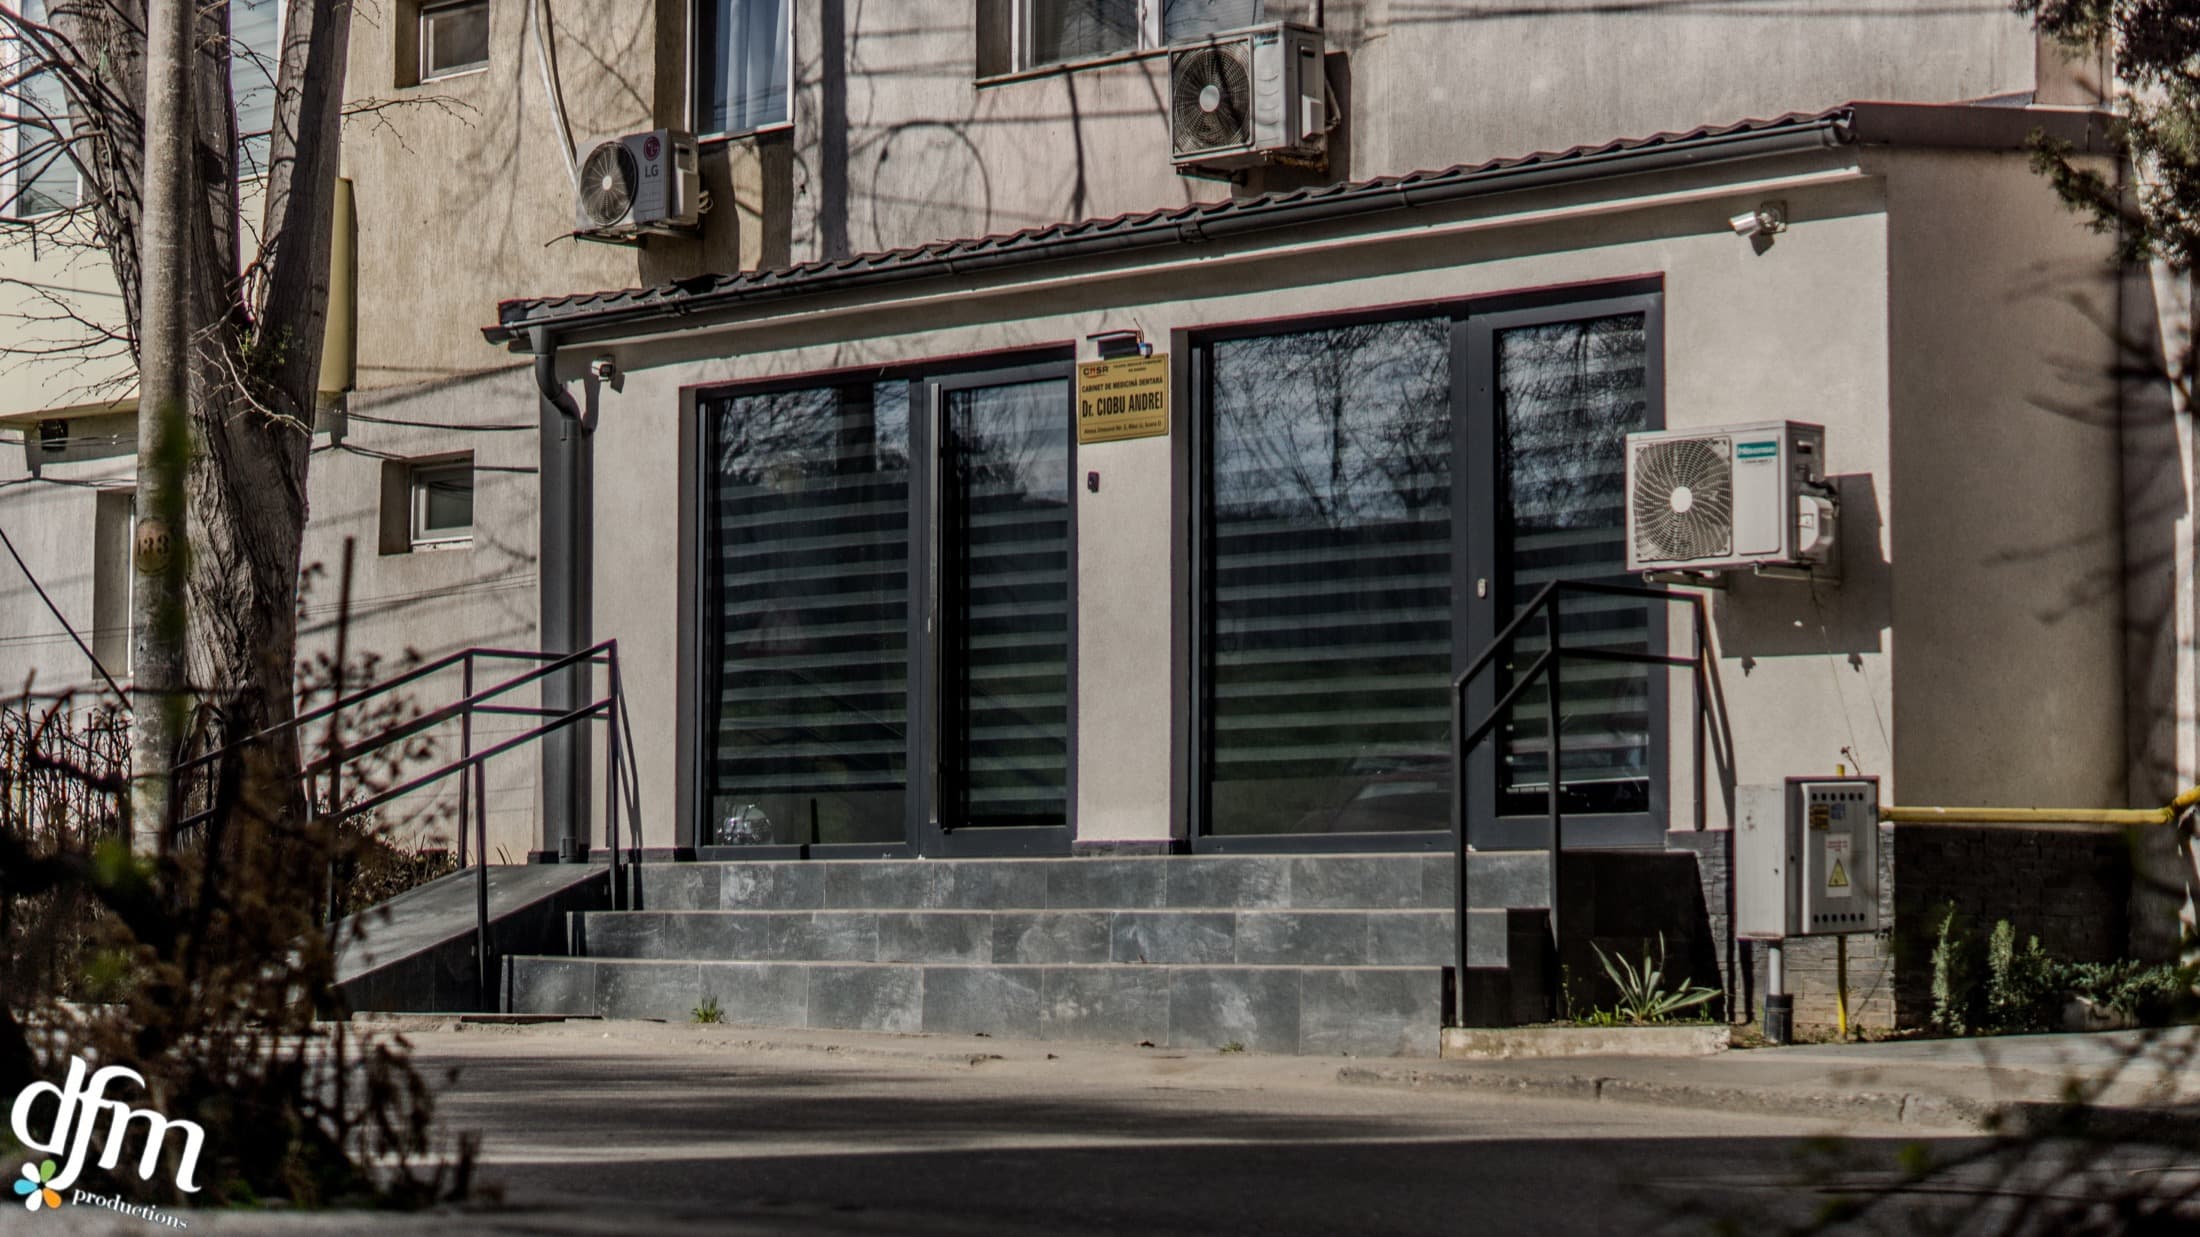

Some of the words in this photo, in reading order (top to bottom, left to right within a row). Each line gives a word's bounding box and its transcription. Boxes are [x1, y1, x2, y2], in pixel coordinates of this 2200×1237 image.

[644, 165, 659, 178] LG
[1082, 383, 1104, 393] CABINET
[1105, 382, 1112, 391] DE
[1082, 400, 1094, 417] Dr.
[1097, 395, 1126, 416] CIOBU
[1128, 391, 1163, 412] ANDREI
[1737, 446, 1776, 456] Hisense
